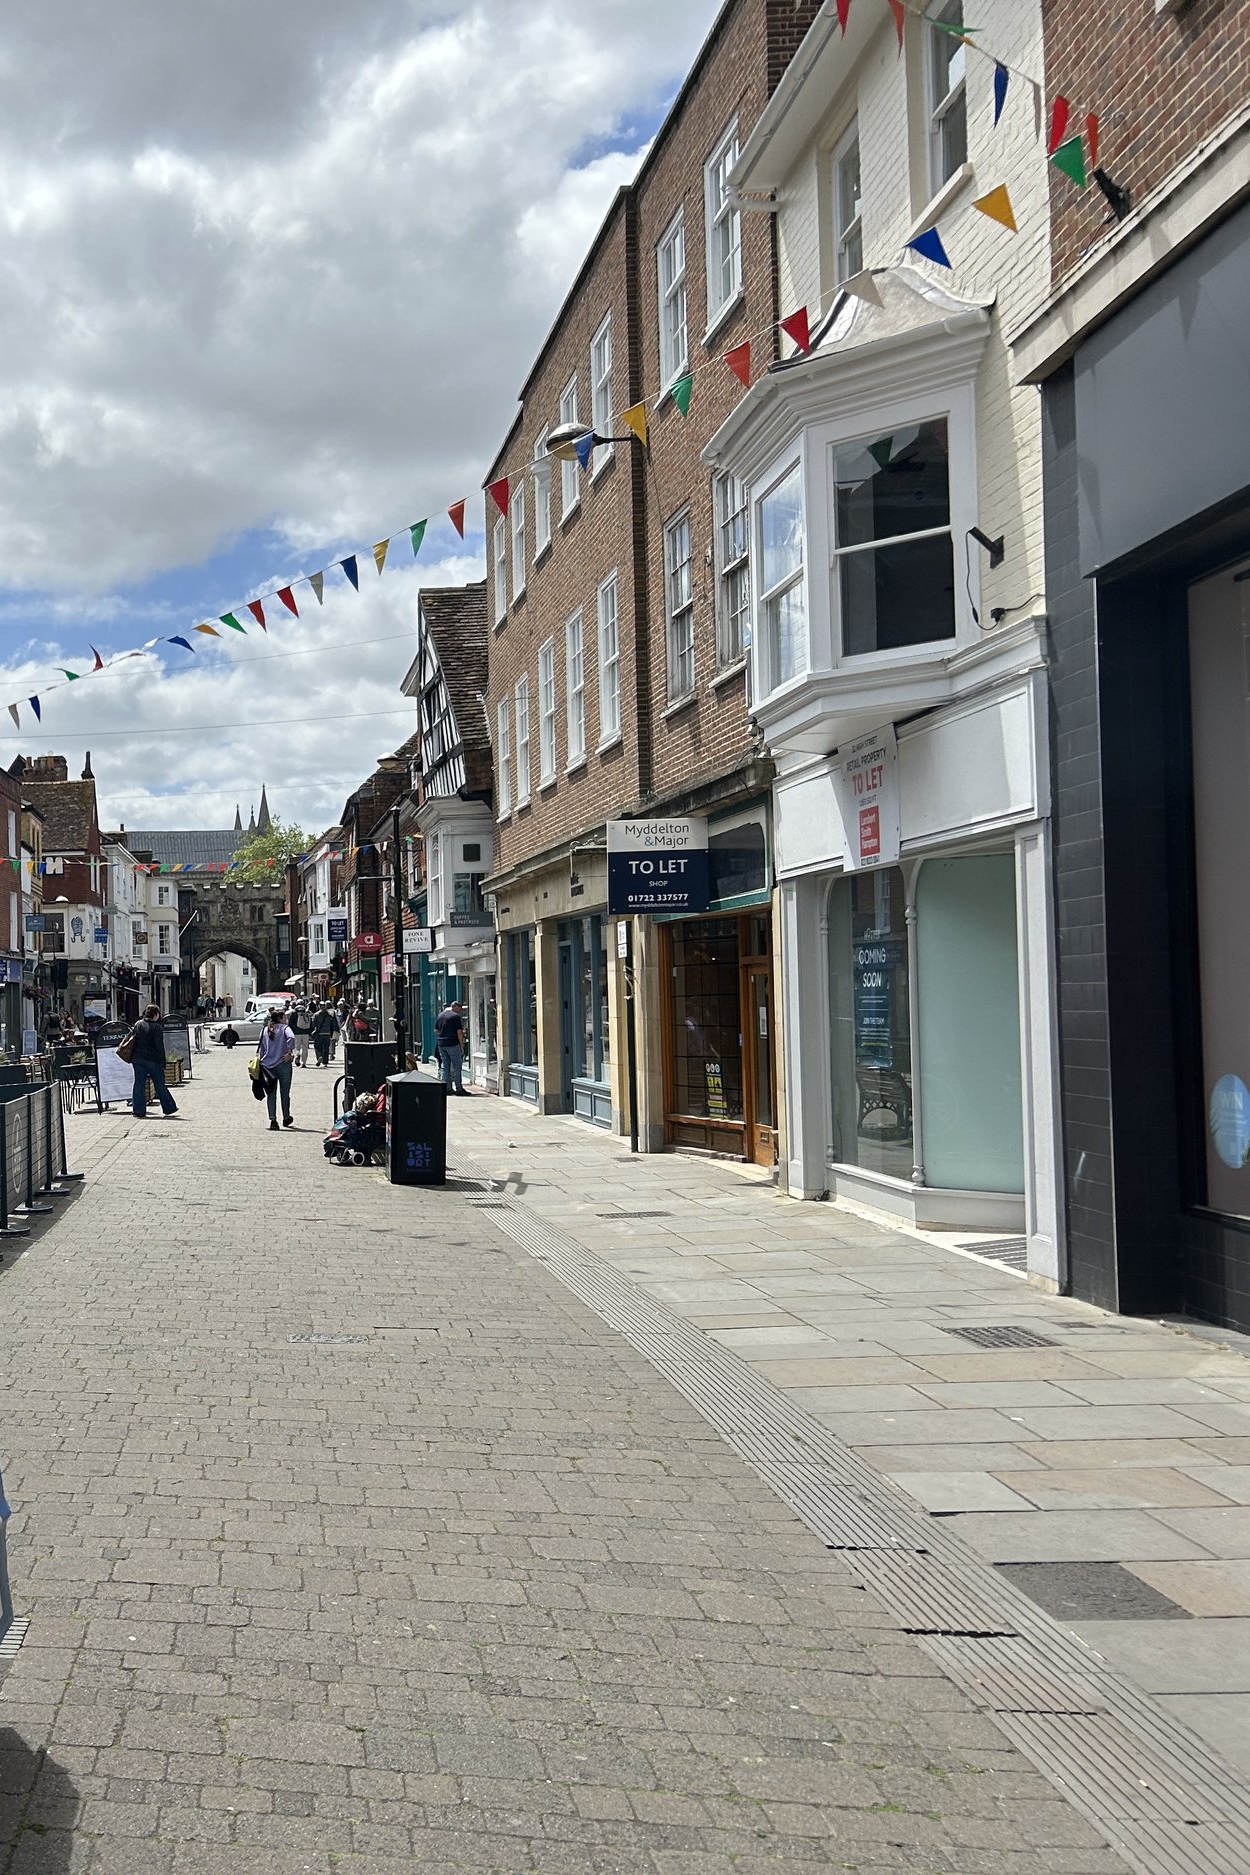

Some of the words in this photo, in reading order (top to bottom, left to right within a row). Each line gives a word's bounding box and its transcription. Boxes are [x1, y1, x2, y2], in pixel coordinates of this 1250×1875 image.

[861, 746, 887, 765] PROPERTY
[852, 772, 863, 796] TO
[865, 765, 883, 792] LET
[625, 823, 690, 838] Myddelton
[628, 860, 654, 875] TO
[659, 859, 688, 874] LET
[627, 894, 655, 903] 01722
[657, 893, 689, 901] 337577
[858, 947, 886, 965] COMING
[862, 971, 882, 988] SOON
